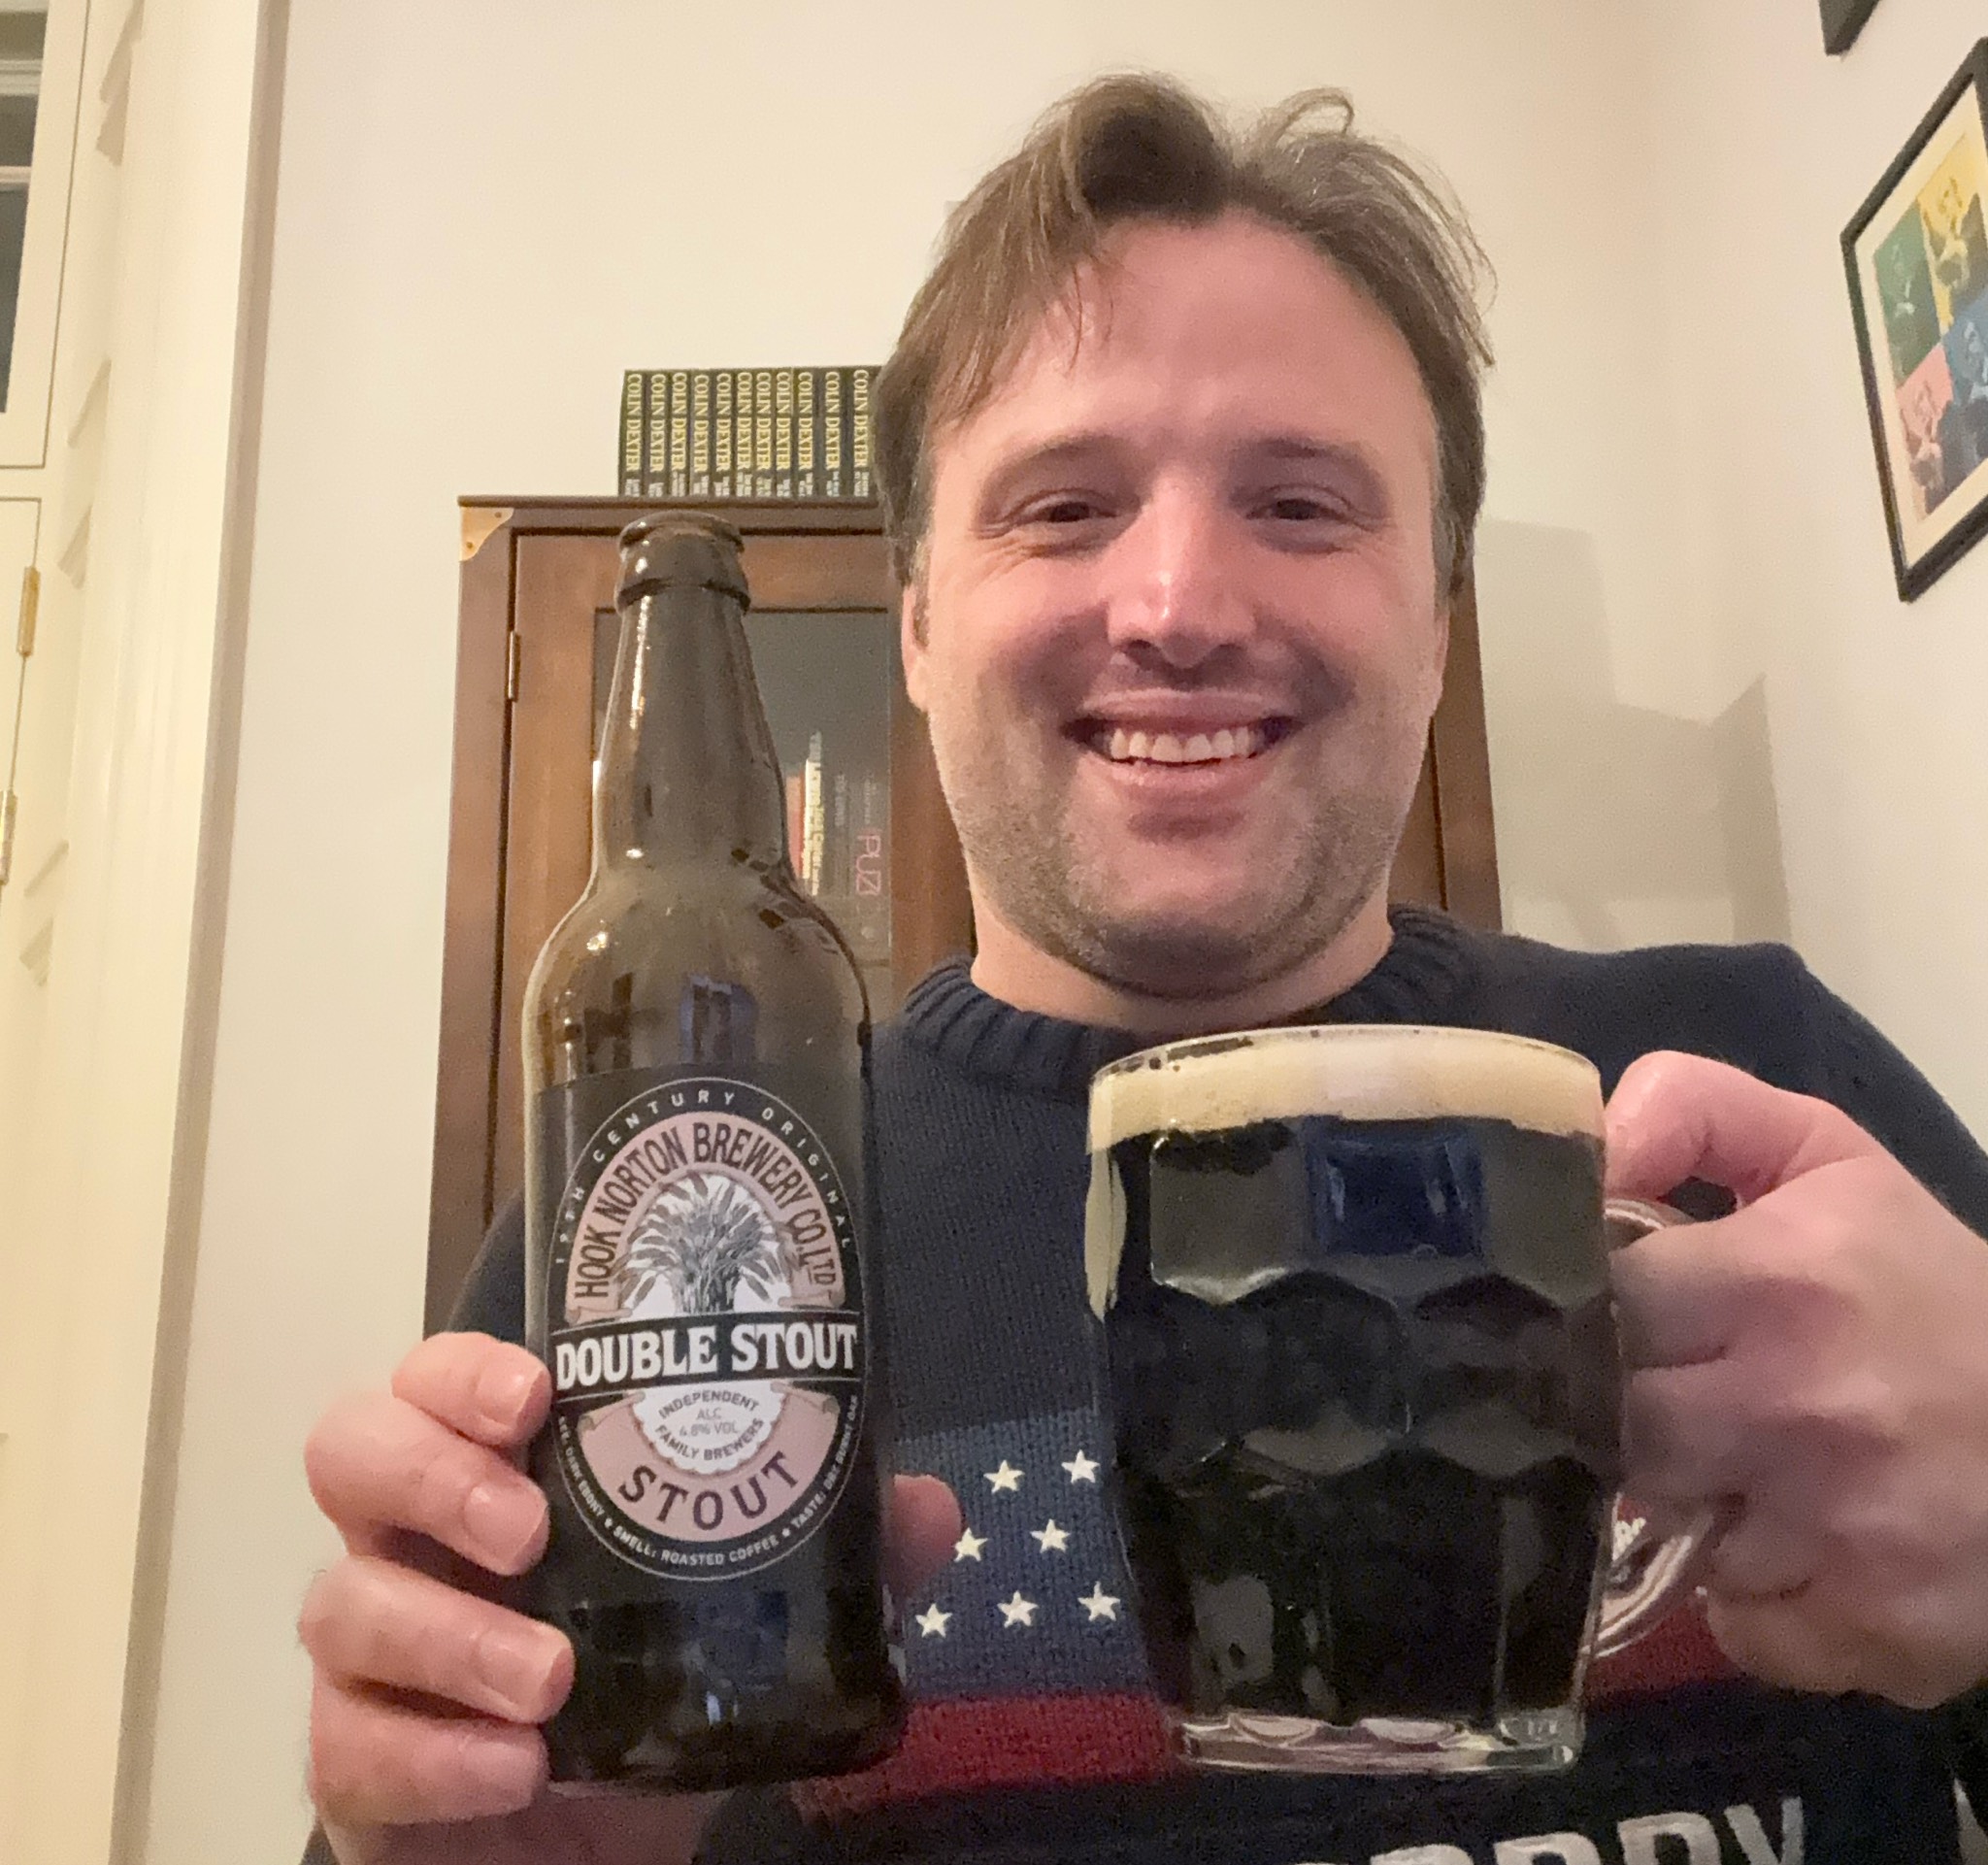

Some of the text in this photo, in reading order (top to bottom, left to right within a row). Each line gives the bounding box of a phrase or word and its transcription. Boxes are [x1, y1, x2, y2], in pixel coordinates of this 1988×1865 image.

[627, 373, 642, 416] COLIN
[650, 373, 666, 416] COLIN
[672, 372, 687, 415] COLIN
[694, 374, 709, 416] COLIN
[716, 373, 731, 416] COLIN
[737, 372, 752, 415] COLIN
[756, 372, 772, 415] COLIN
[777, 372, 791, 415] COLIN
[798, 372, 812, 415] COLIN
[825, 371, 840, 415] COLIN
[853, 369, 869, 412] COLIN
[625, 418, 642, 472] DEXTER
[649, 418, 665, 472] DEXTER
[671, 417, 687, 471] DEXTER
[693, 419, 709, 473] DEXTER
[715, 418, 731, 472] DEXTER
[737, 416, 752, 470] DEXTER
[756, 417, 771, 471] DEXTER
[777, 417, 790, 471] DEXTER
[798, 417, 812, 471] DEXTER
[825, 416, 840, 471] DEXTER
[853, 415, 869, 468] DEXTER
[591, 1125, 689, 1225] NORTON
[592, 1088, 736, 1163] CENTURY
[761, 1107, 851, 1249] ORIGINAL
[692, 1121, 814, 1210] BREWERY
[574, 1223, 622, 1299] HOOK
[555, 1321, 858, 1391] DOUBLE STOUT
[658, 1389, 760, 1419] INDEPENDENT
[696, 1407, 722, 1420] ALC
[713, 1421, 739, 1435] VOL
[654, 1417, 765, 1461] FAMILY BREWERS
[578, 1480, 606, 1517] EBONY
[617, 1449, 799, 1531] STOUT
[613, 1524, 780, 1566] SMELL: ROASTED COFFEE
